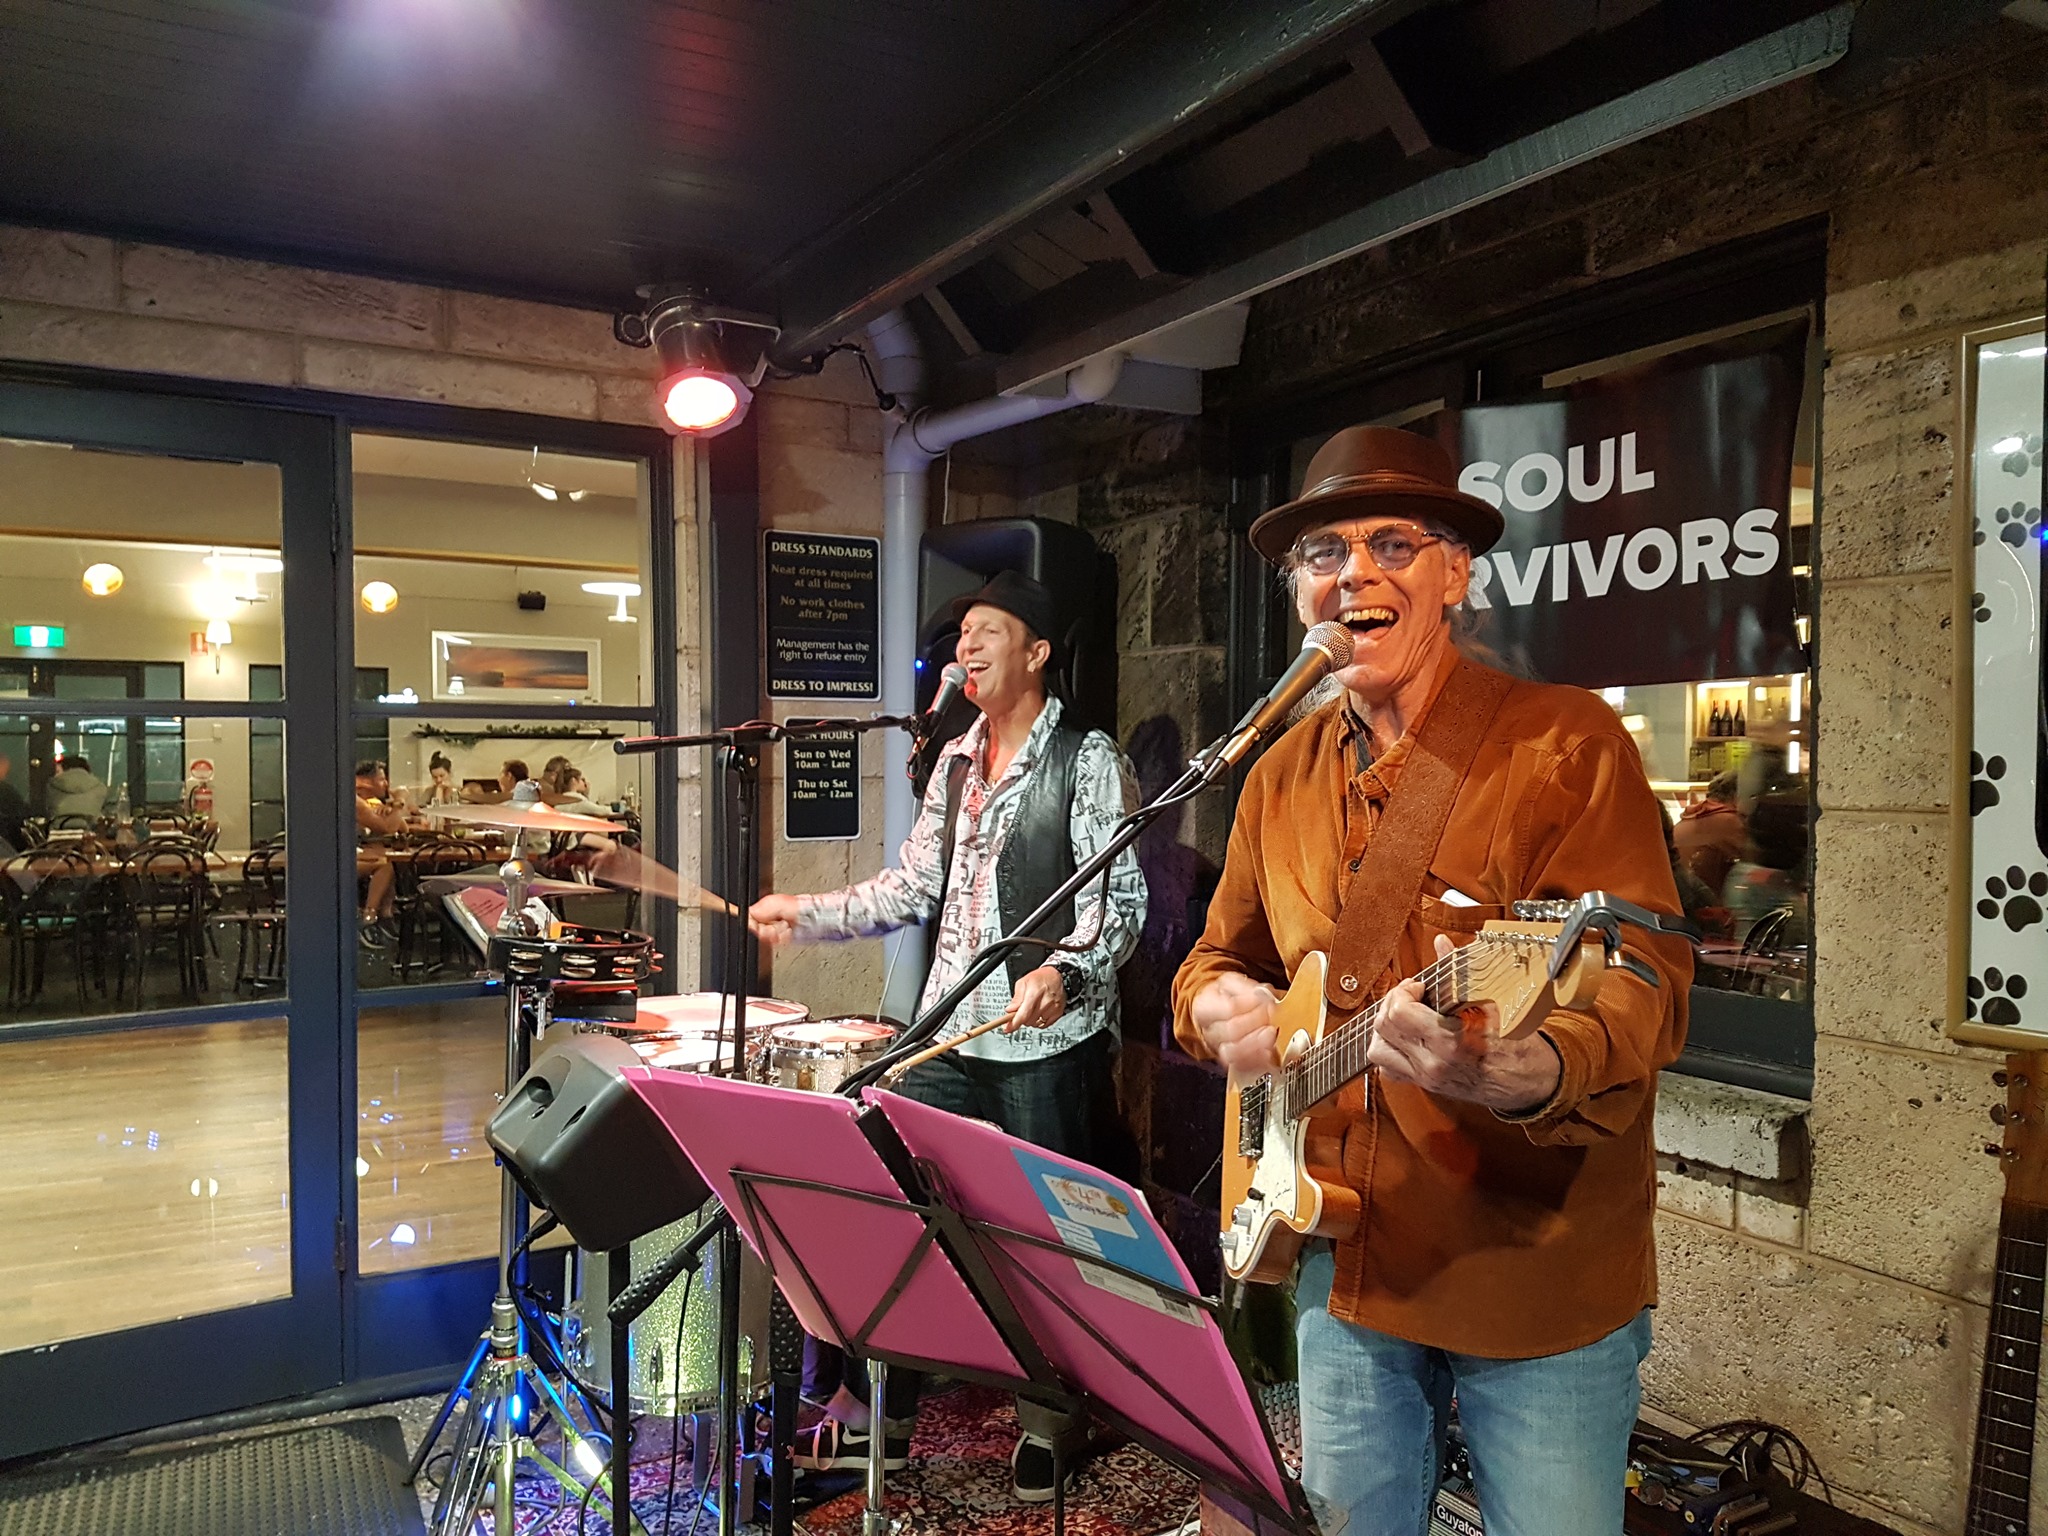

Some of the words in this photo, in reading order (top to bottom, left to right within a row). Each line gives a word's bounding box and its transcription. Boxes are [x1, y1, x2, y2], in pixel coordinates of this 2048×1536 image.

[1457, 431, 1655, 512] SOUL
[771, 541, 806, 554] DRESS
[808, 545, 873, 559] STANDARDS
[771, 564, 796, 575] Neat
[799, 566, 827, 577] dress
[830, 569, 873, 581] required
[794, 578, 805, 587] at
[808, 578, 821, 588] all
[823, 579, 852, 590] times
[780, 595, 796, 606] No
[800, 597, 825, 607] work
[828, 598, 865, 610] clothes
[798, 609, 822, 619] after
[826, 610, 849, 622] 7pm
[776, 638, 836, 651] Management
[838, 640, 853, 650] has
[855, 641, 870, 651] the
[779, 651, 801, 662] right
[803, 651, 814, 660] to
[815, 651, 842, 661] refuse
[844, 652, 867, 664] entry
[772, 679, 806, 691] DRESS
[809, 680, 824, 692] TO
[827, 680, 874, 693] IMPRESS!
[820, 730, 855, 740] HOURS
[793, 749, 813, 759] Sun
[815, 750, 826, 758] to
[828, 749, 851, 759] Wed
[795, 760, 820, 769] 10am
[831, 760, 851, 769] Late
[798, 779, 816, 788] Thu
[819, 780, 830, 788] to
[832, 779, 848, 788] Sat
[792, 790, 817, 799] 10am
[829, 790, 854, 798] 12am
